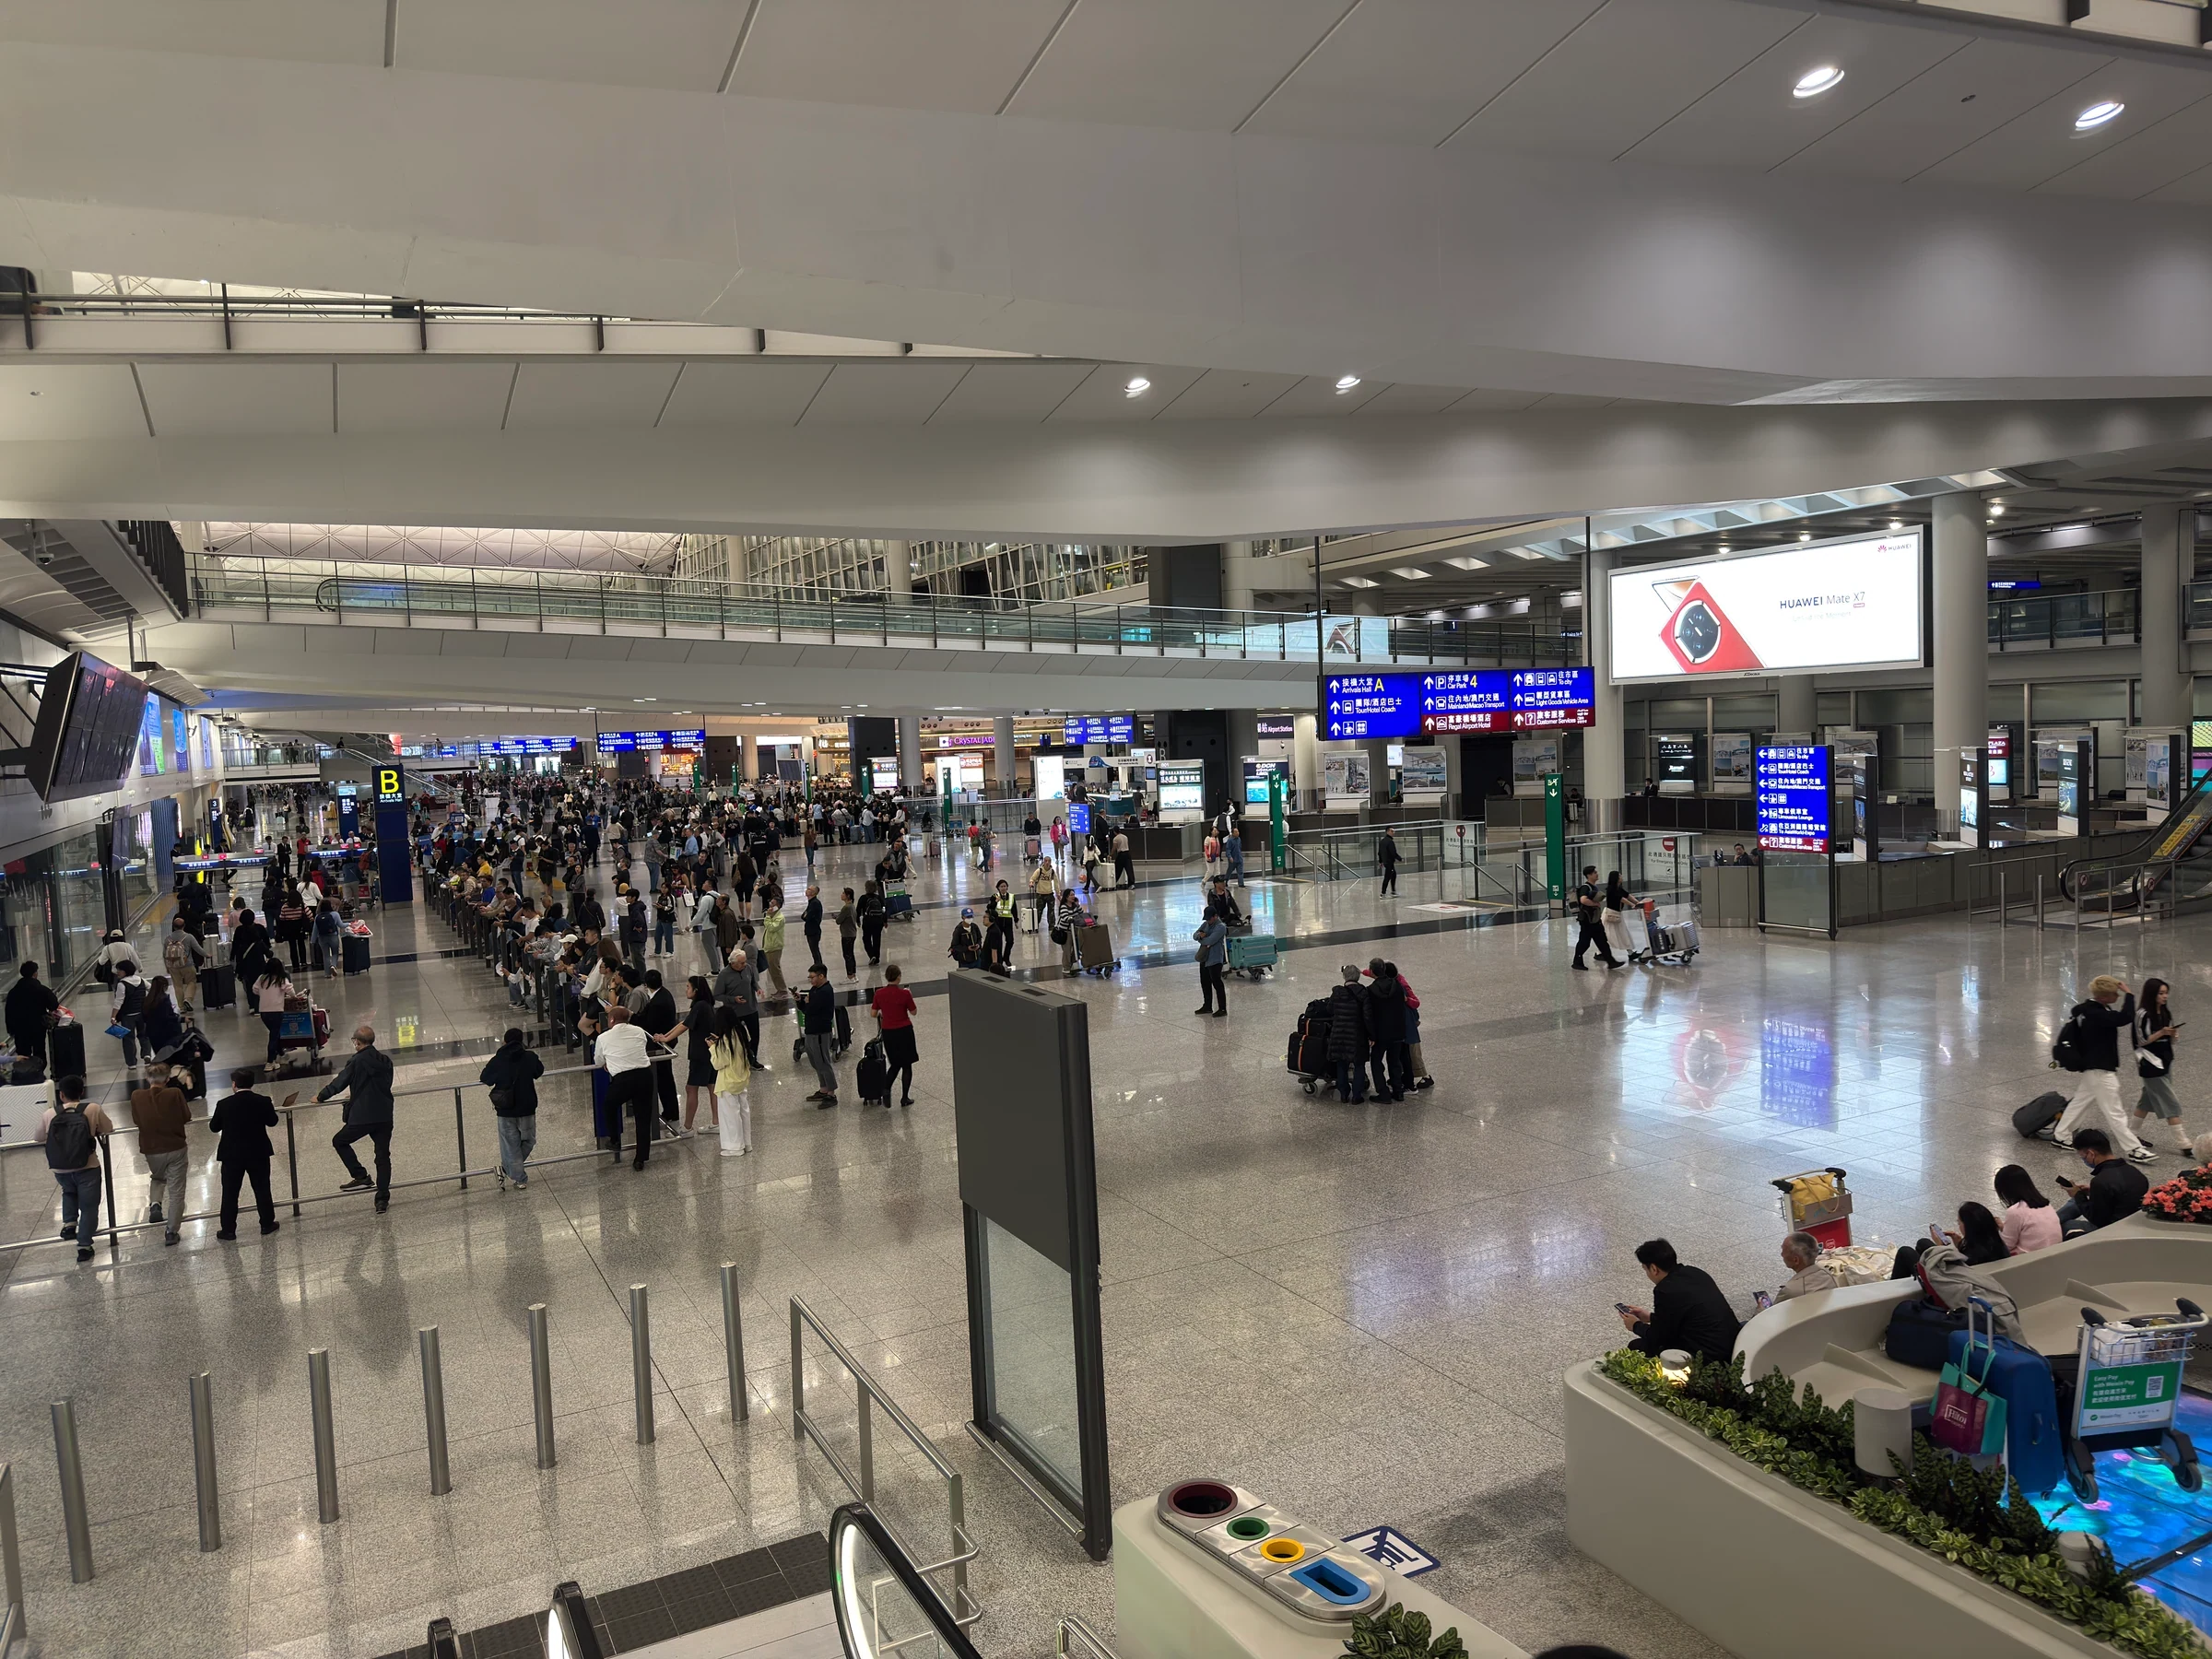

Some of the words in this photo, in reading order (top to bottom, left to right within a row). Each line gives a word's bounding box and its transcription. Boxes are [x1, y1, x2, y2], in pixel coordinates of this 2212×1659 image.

[1780, 596, 1823, 609] HUAWEI
[1827, 594, 1851, 605] Mate
[1853, 591, 1865, 602] X7
[1447, 675, 1469, 683] 停車場
[1558, 670, 1578, 678] 往市區
[1342, 677, 1373, 687] 接機大堂
[1374, 677, 1384, 692] A
[1470, 675, 1477, 688] 4
[954, 737, 981, 746] CRYSTAL
[381, 770, 399, 793] B
